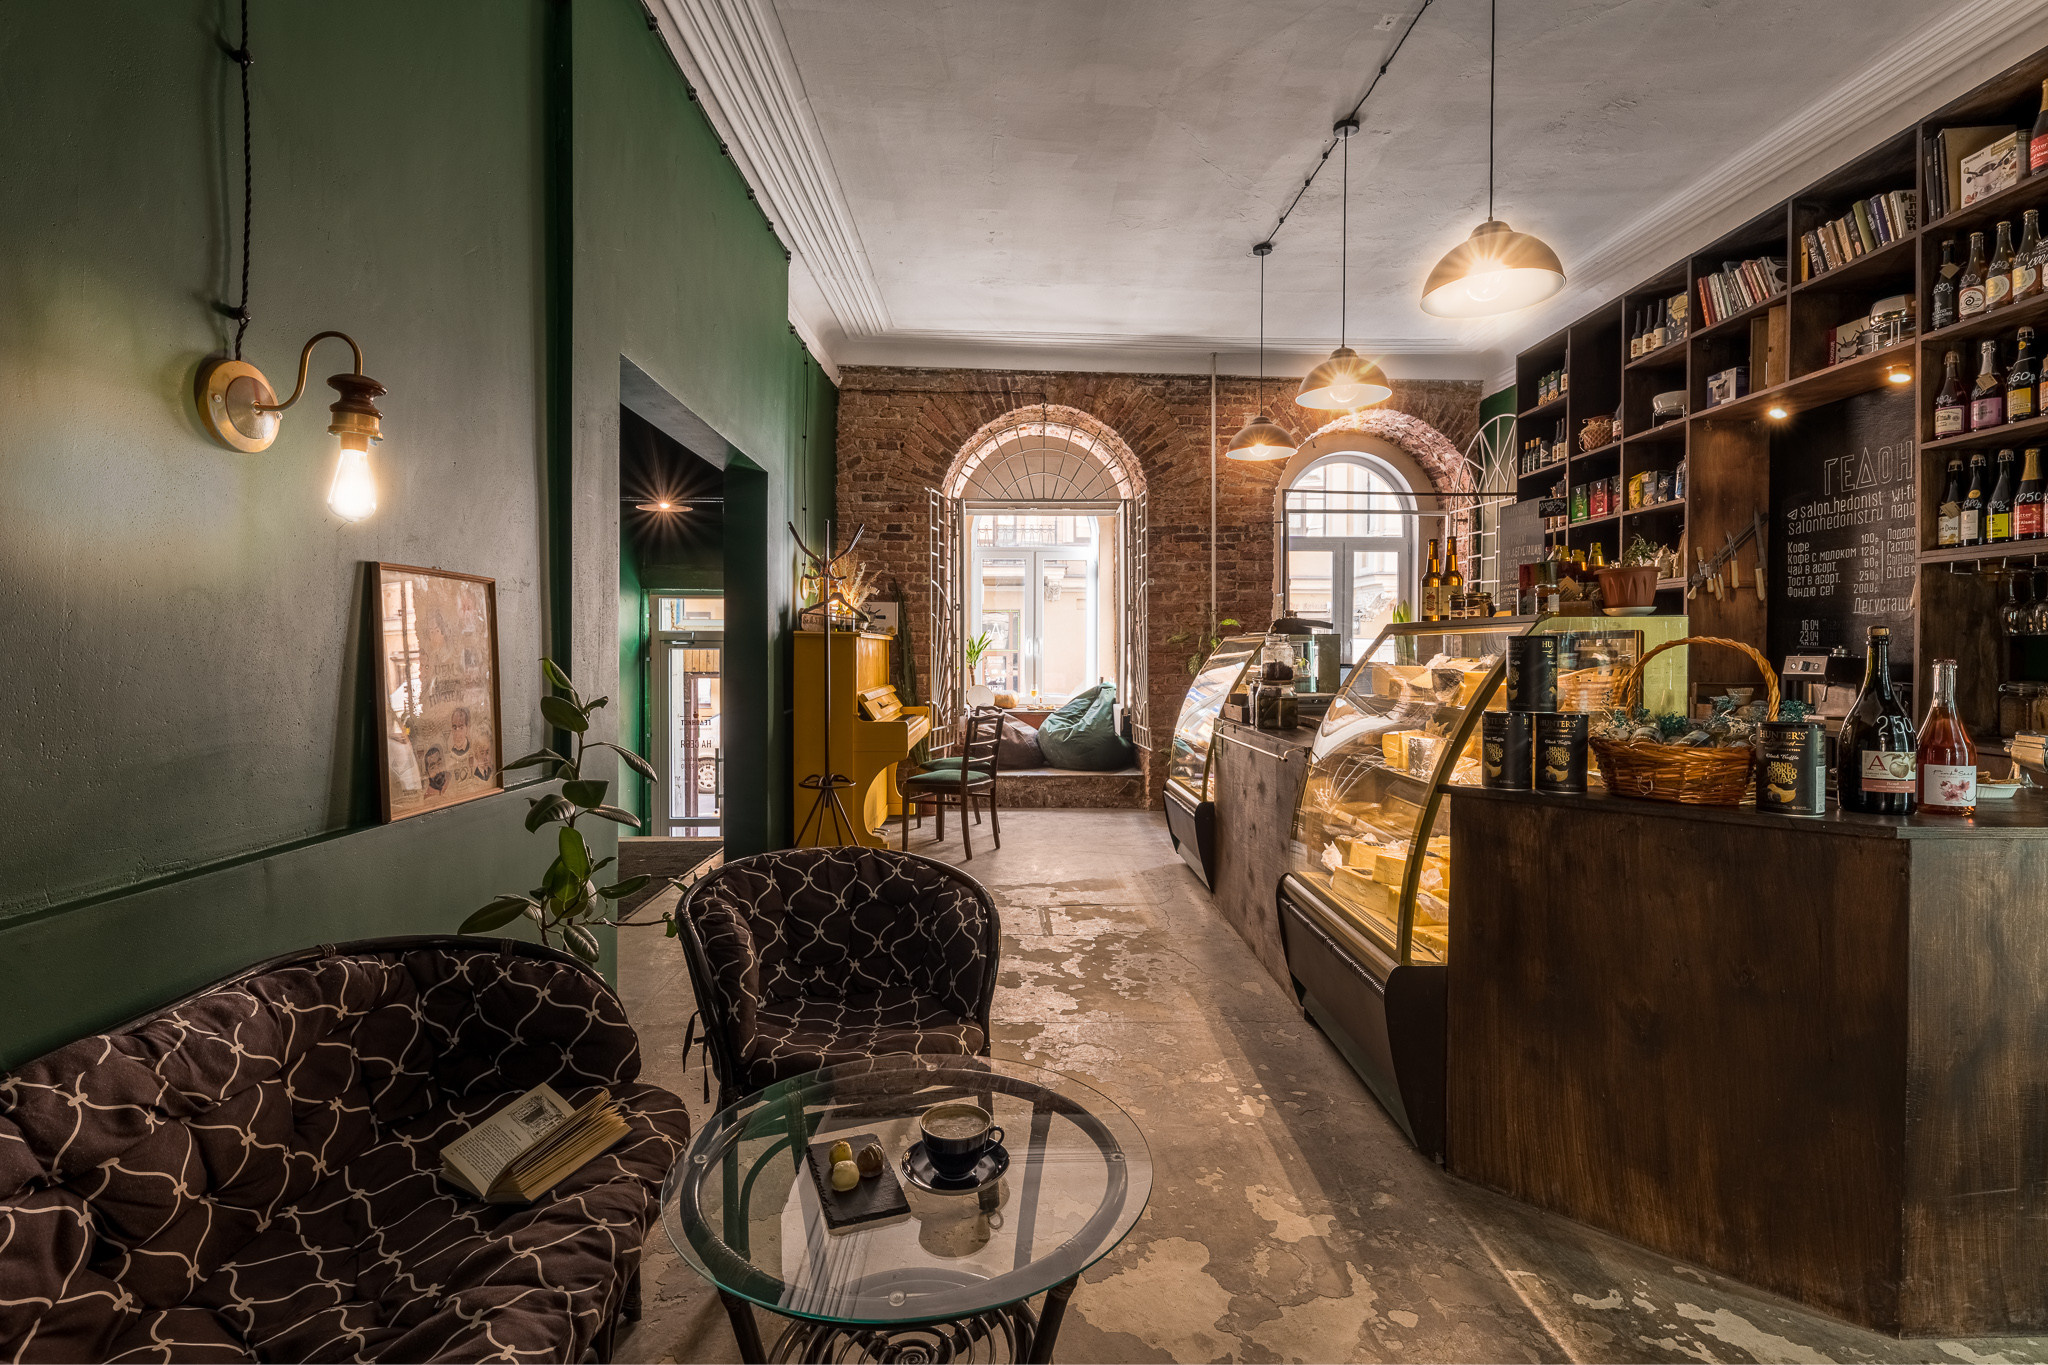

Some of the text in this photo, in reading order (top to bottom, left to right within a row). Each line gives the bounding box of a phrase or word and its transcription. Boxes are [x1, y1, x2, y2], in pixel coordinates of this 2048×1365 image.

[1800, 491, 1883, 519] salon_hedonist
[1788, 507, 1884, 536] salonhedonist.ru
[1787, 542, 1810, 554] Кофе
[1787, 553, 1810, 565] Кофе
[1759, 729, 1807, 740] HUNTER'S
[1866, 755, 1888, 771] A
